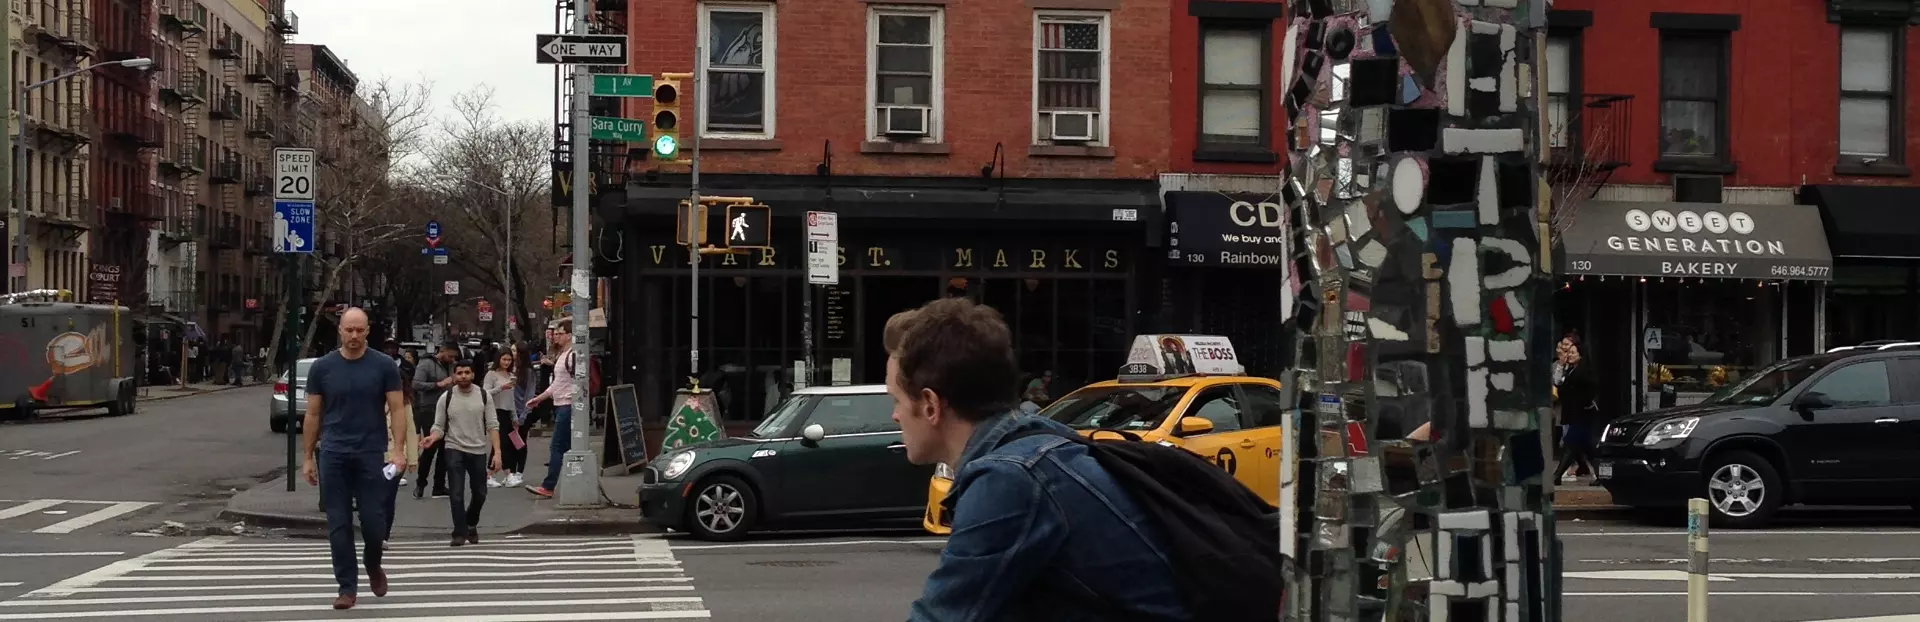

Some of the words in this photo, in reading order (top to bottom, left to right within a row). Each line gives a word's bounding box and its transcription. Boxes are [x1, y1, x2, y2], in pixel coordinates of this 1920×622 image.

[550, 43, 576, 55] ONE
[588, 44, 616, 56] WAY
[612, 77, 617, 94] 1
[622, 77, 633, 86] AV
[592, 118, 614, 130] Sara
[617, 120, 643, 136] Curry
[279, 154, 311, 163] SPEED
[281, 164, 309, 173] LIMIT
[280, 175, 310, 194] 20
[290, 207, 311, 216] SLOW
[290, 215, 311, 224] ZONE
[1632, 214, 1747, 229] SWEET
[1221, 233, 1240, 243] We
[1241, 233, 1262, 245] buy
[1607, 236, 1786, 256] GENERATION
[954, 247, 1119, 269] MARKS
[1187, 253, 1205, 263] 130
[1220, 251, 1280, 264] Rainbow
[1571, 260, 1592, 271] 130
[1661, 261, 1739, 275] BAKERY
[1771, 265, 1830, 277] 646.964.5777
[90, 272, 120, 281] COURT
[1648, 330, 1659, 344] A
[1208, 347, 1234, 361] BOSS
[1128, 364, 1147, 374] 3B38
